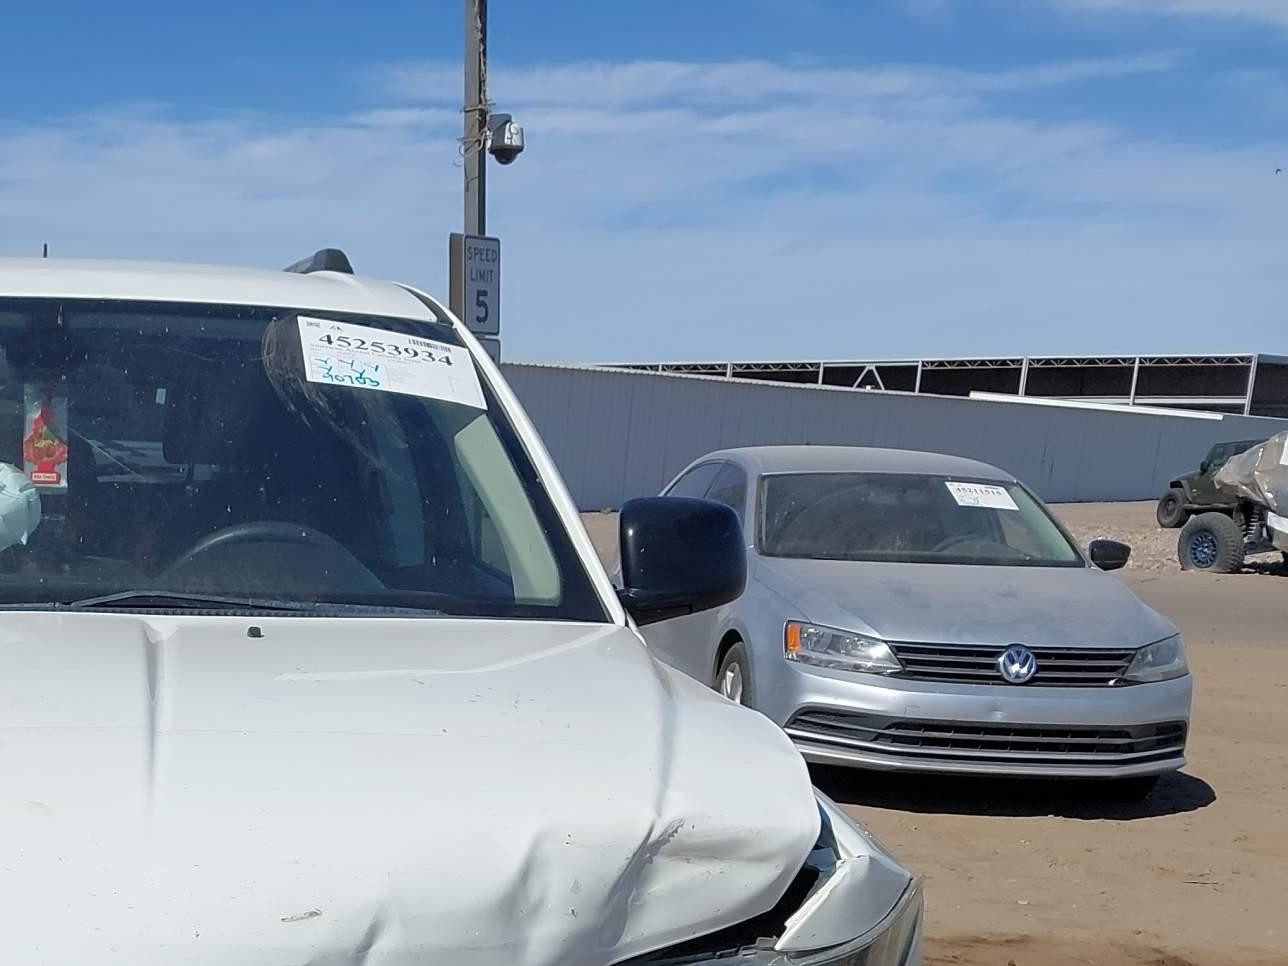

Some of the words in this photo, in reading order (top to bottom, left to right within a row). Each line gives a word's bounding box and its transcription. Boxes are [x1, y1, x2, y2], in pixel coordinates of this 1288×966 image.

[467, 246, 498, 262] SPEED
[470, 268, 494, 282] LIMIT
[475, 289, 489, 324] 5
[318, 333, 455, 367] 45253934
